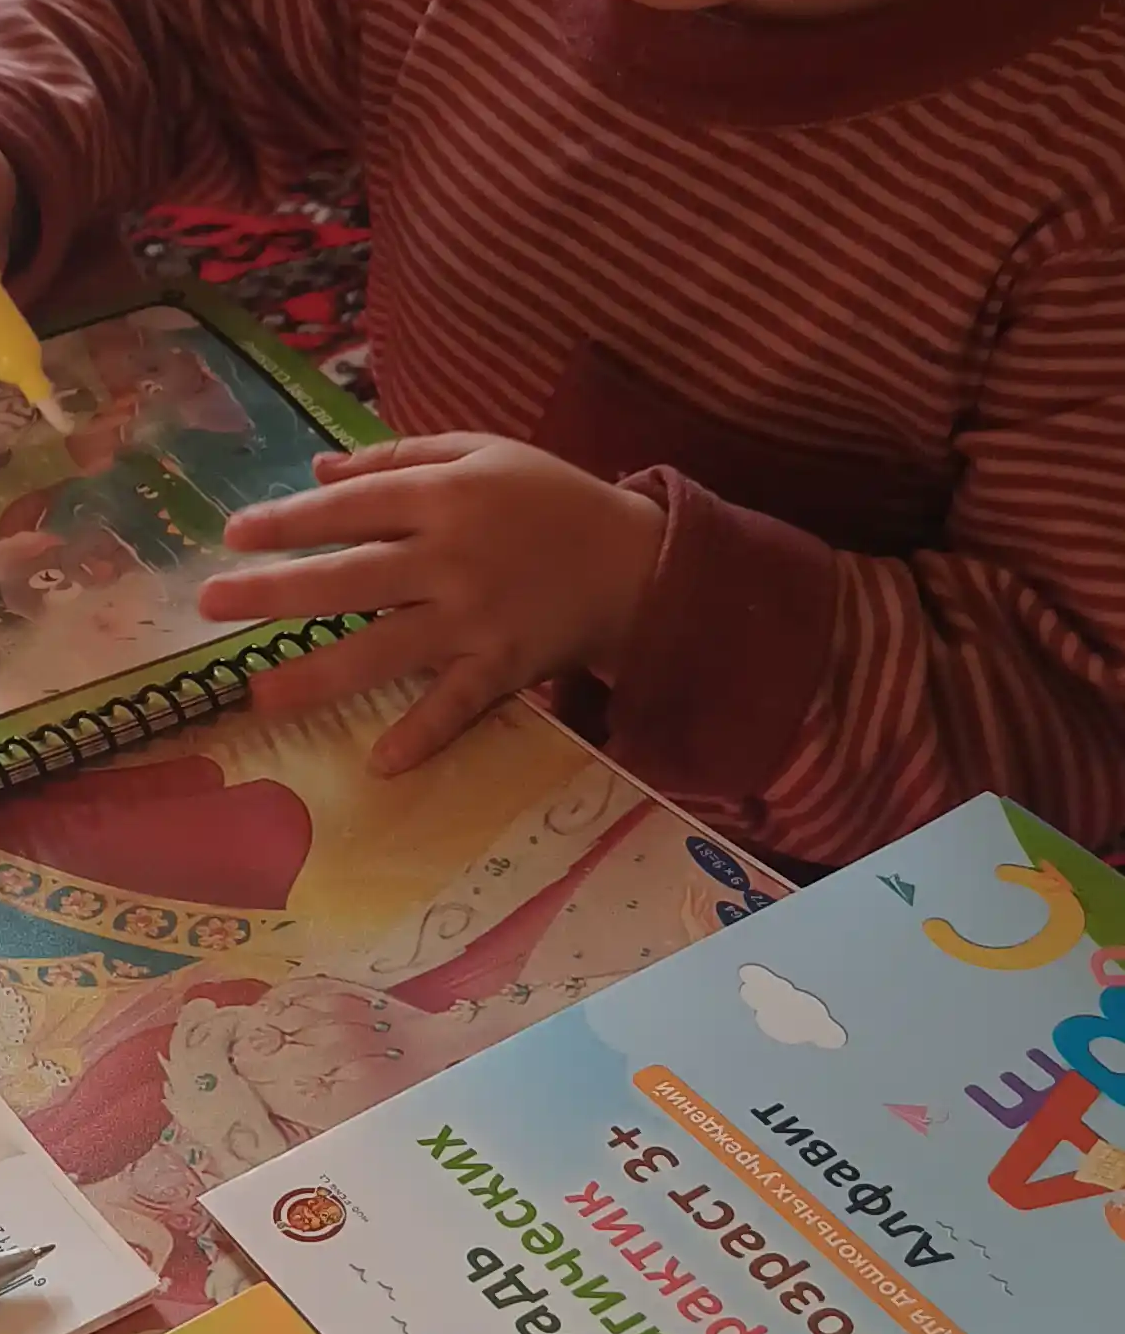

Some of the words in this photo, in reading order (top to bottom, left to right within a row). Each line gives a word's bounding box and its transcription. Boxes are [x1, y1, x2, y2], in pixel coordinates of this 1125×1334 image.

[606, 1122, 681, 1185] 3+
[652, 1078, 783, 1187] учреждений
[751, 1101, 957, 1269] Алфавит
[773, 1182, 917, 1309] дошкольных
